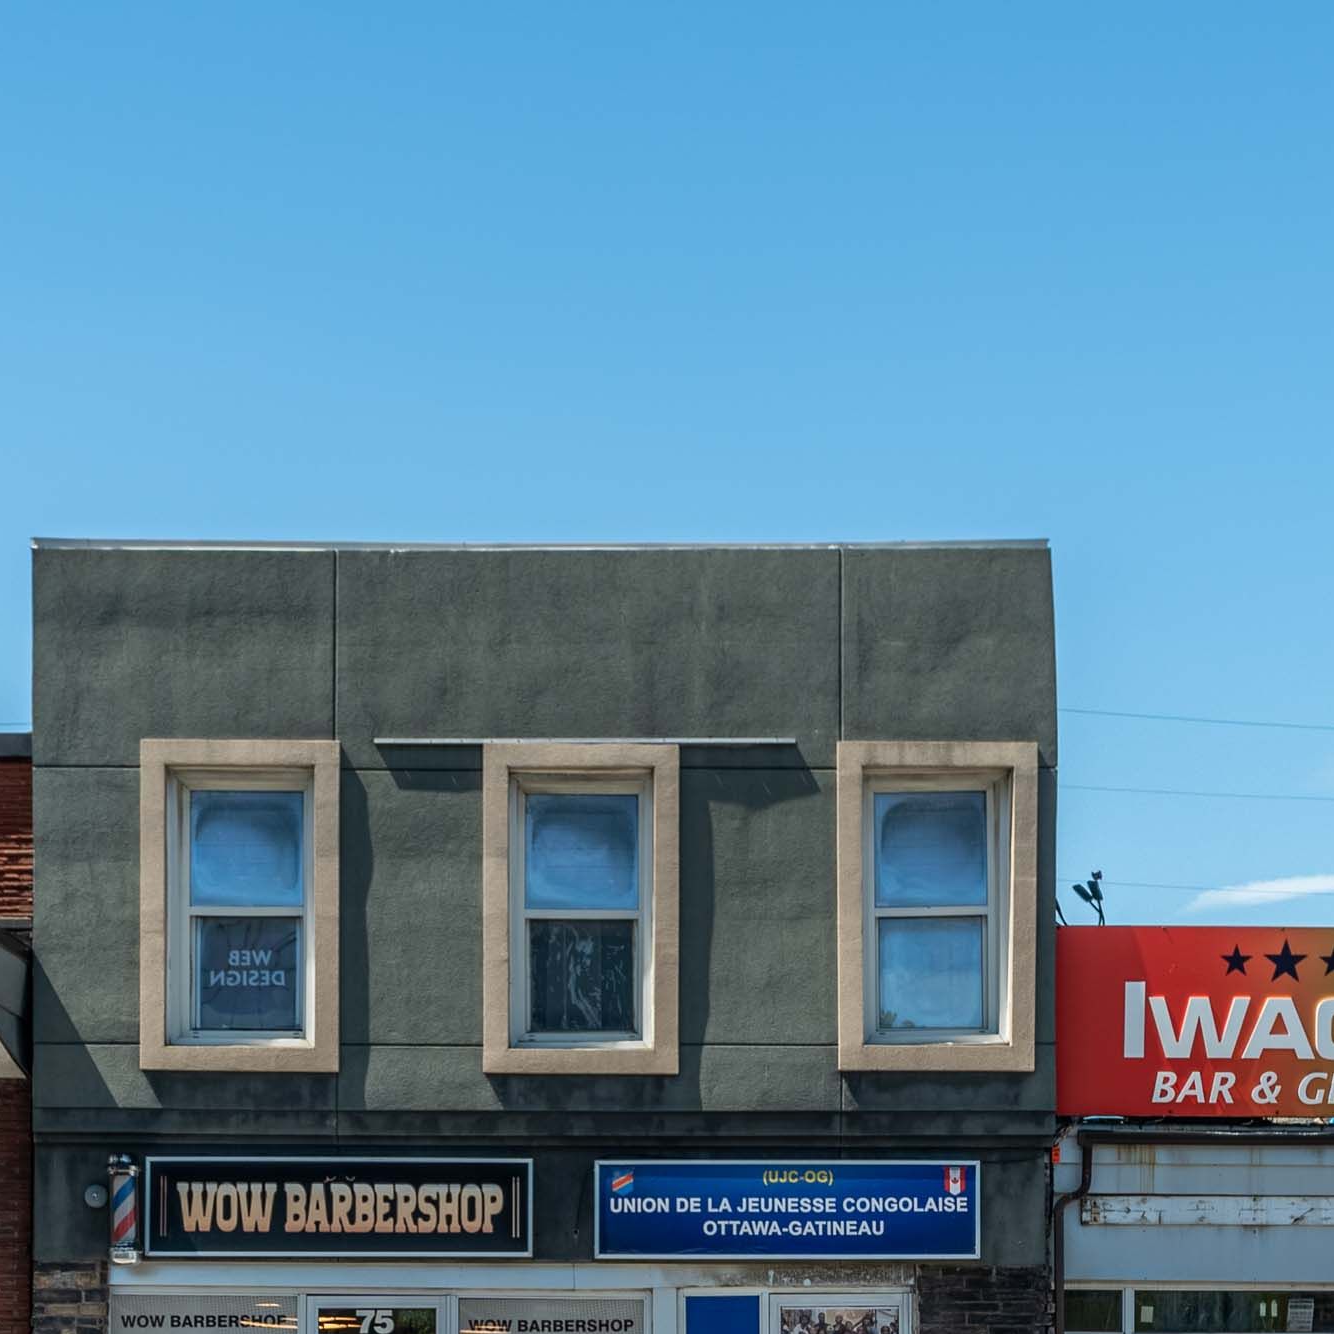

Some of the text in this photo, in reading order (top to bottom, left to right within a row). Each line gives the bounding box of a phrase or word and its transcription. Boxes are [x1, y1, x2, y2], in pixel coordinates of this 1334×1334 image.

[1151, 1071, 1236, 1104] BAR
[1251, 1071, 1282, 1105] &
[762, 1169, 834, 1186] (UJC-OG)
[176, 1180, 504, 1234] WOW BARBERSHOP
[610, 1196, 968, 1214] UNION DE LA JEUNESSE CONGOLAISE
[702, 1219, 885, 1237] OTTAWA-GATINEAU
[121, 1315, 165, 1328] WOW
[355, 1309, 395, 1334] 75
[468, 1319, 634, 1333] WOW BARBERSHOP
